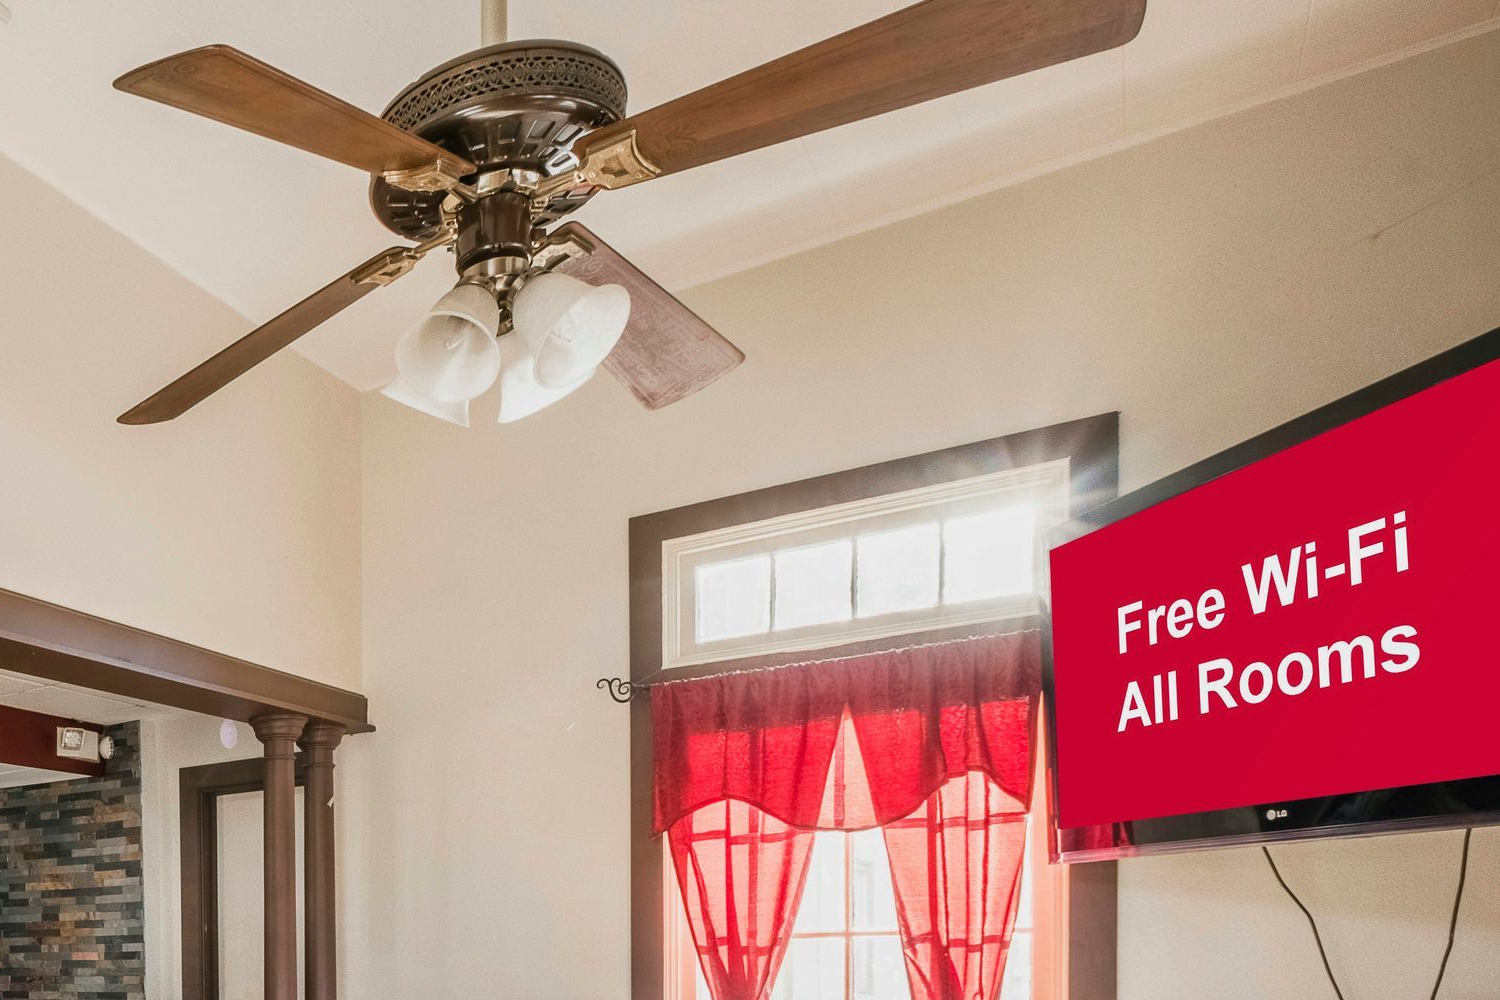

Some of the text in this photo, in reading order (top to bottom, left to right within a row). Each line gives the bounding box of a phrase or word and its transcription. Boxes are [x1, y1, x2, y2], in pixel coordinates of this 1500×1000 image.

[1116, 510, 1409, 655] Free Wi-Fi
[1116, 624, 1421, 733] All Rooms
